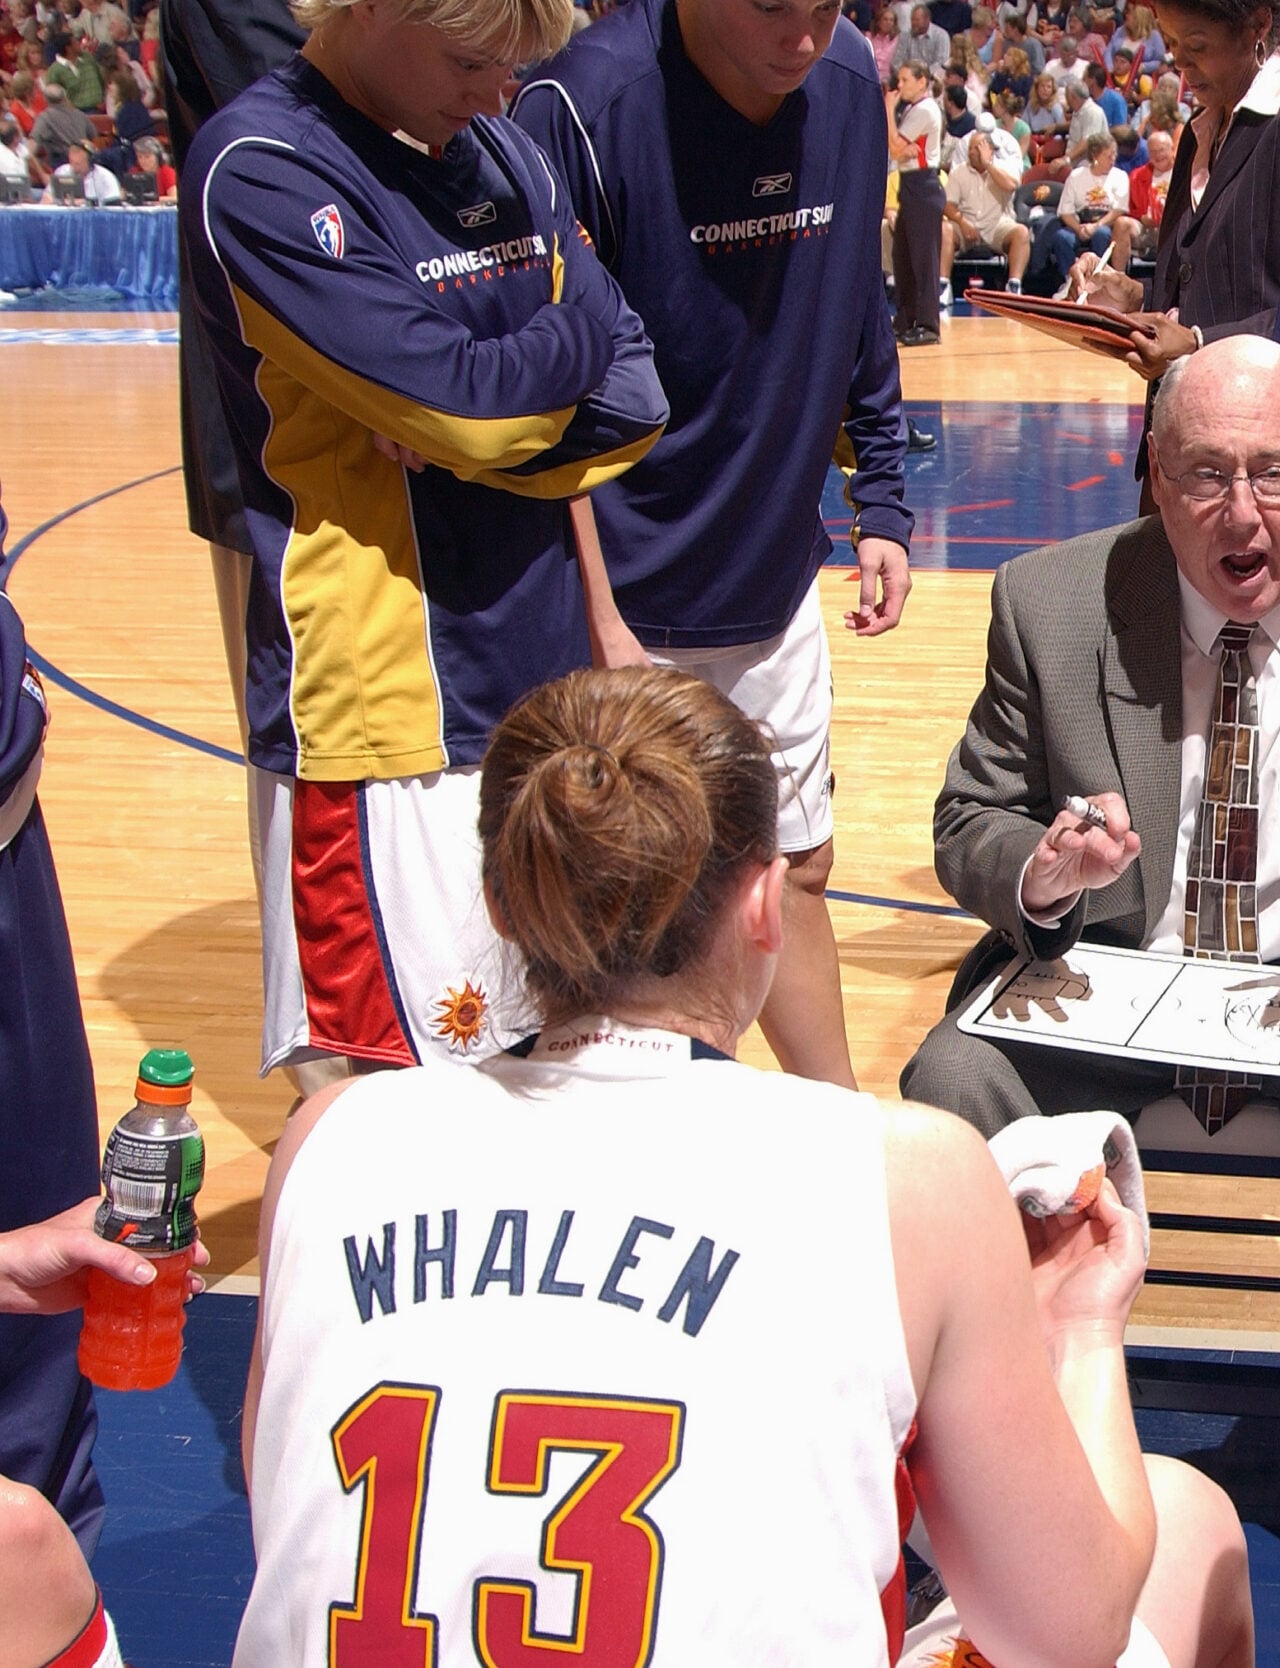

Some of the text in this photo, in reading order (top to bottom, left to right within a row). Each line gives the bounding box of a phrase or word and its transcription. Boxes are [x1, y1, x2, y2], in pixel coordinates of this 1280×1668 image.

[690, 208, 812, 243] CONNECTICUT
[415, 236, 535, 283] CONNECTICUT
[547, 1032, 675, 1053] CONNECTICUT
[343, 1209, 741, 1338] WHALEN
[329, 1380, 687, 1668] 13
